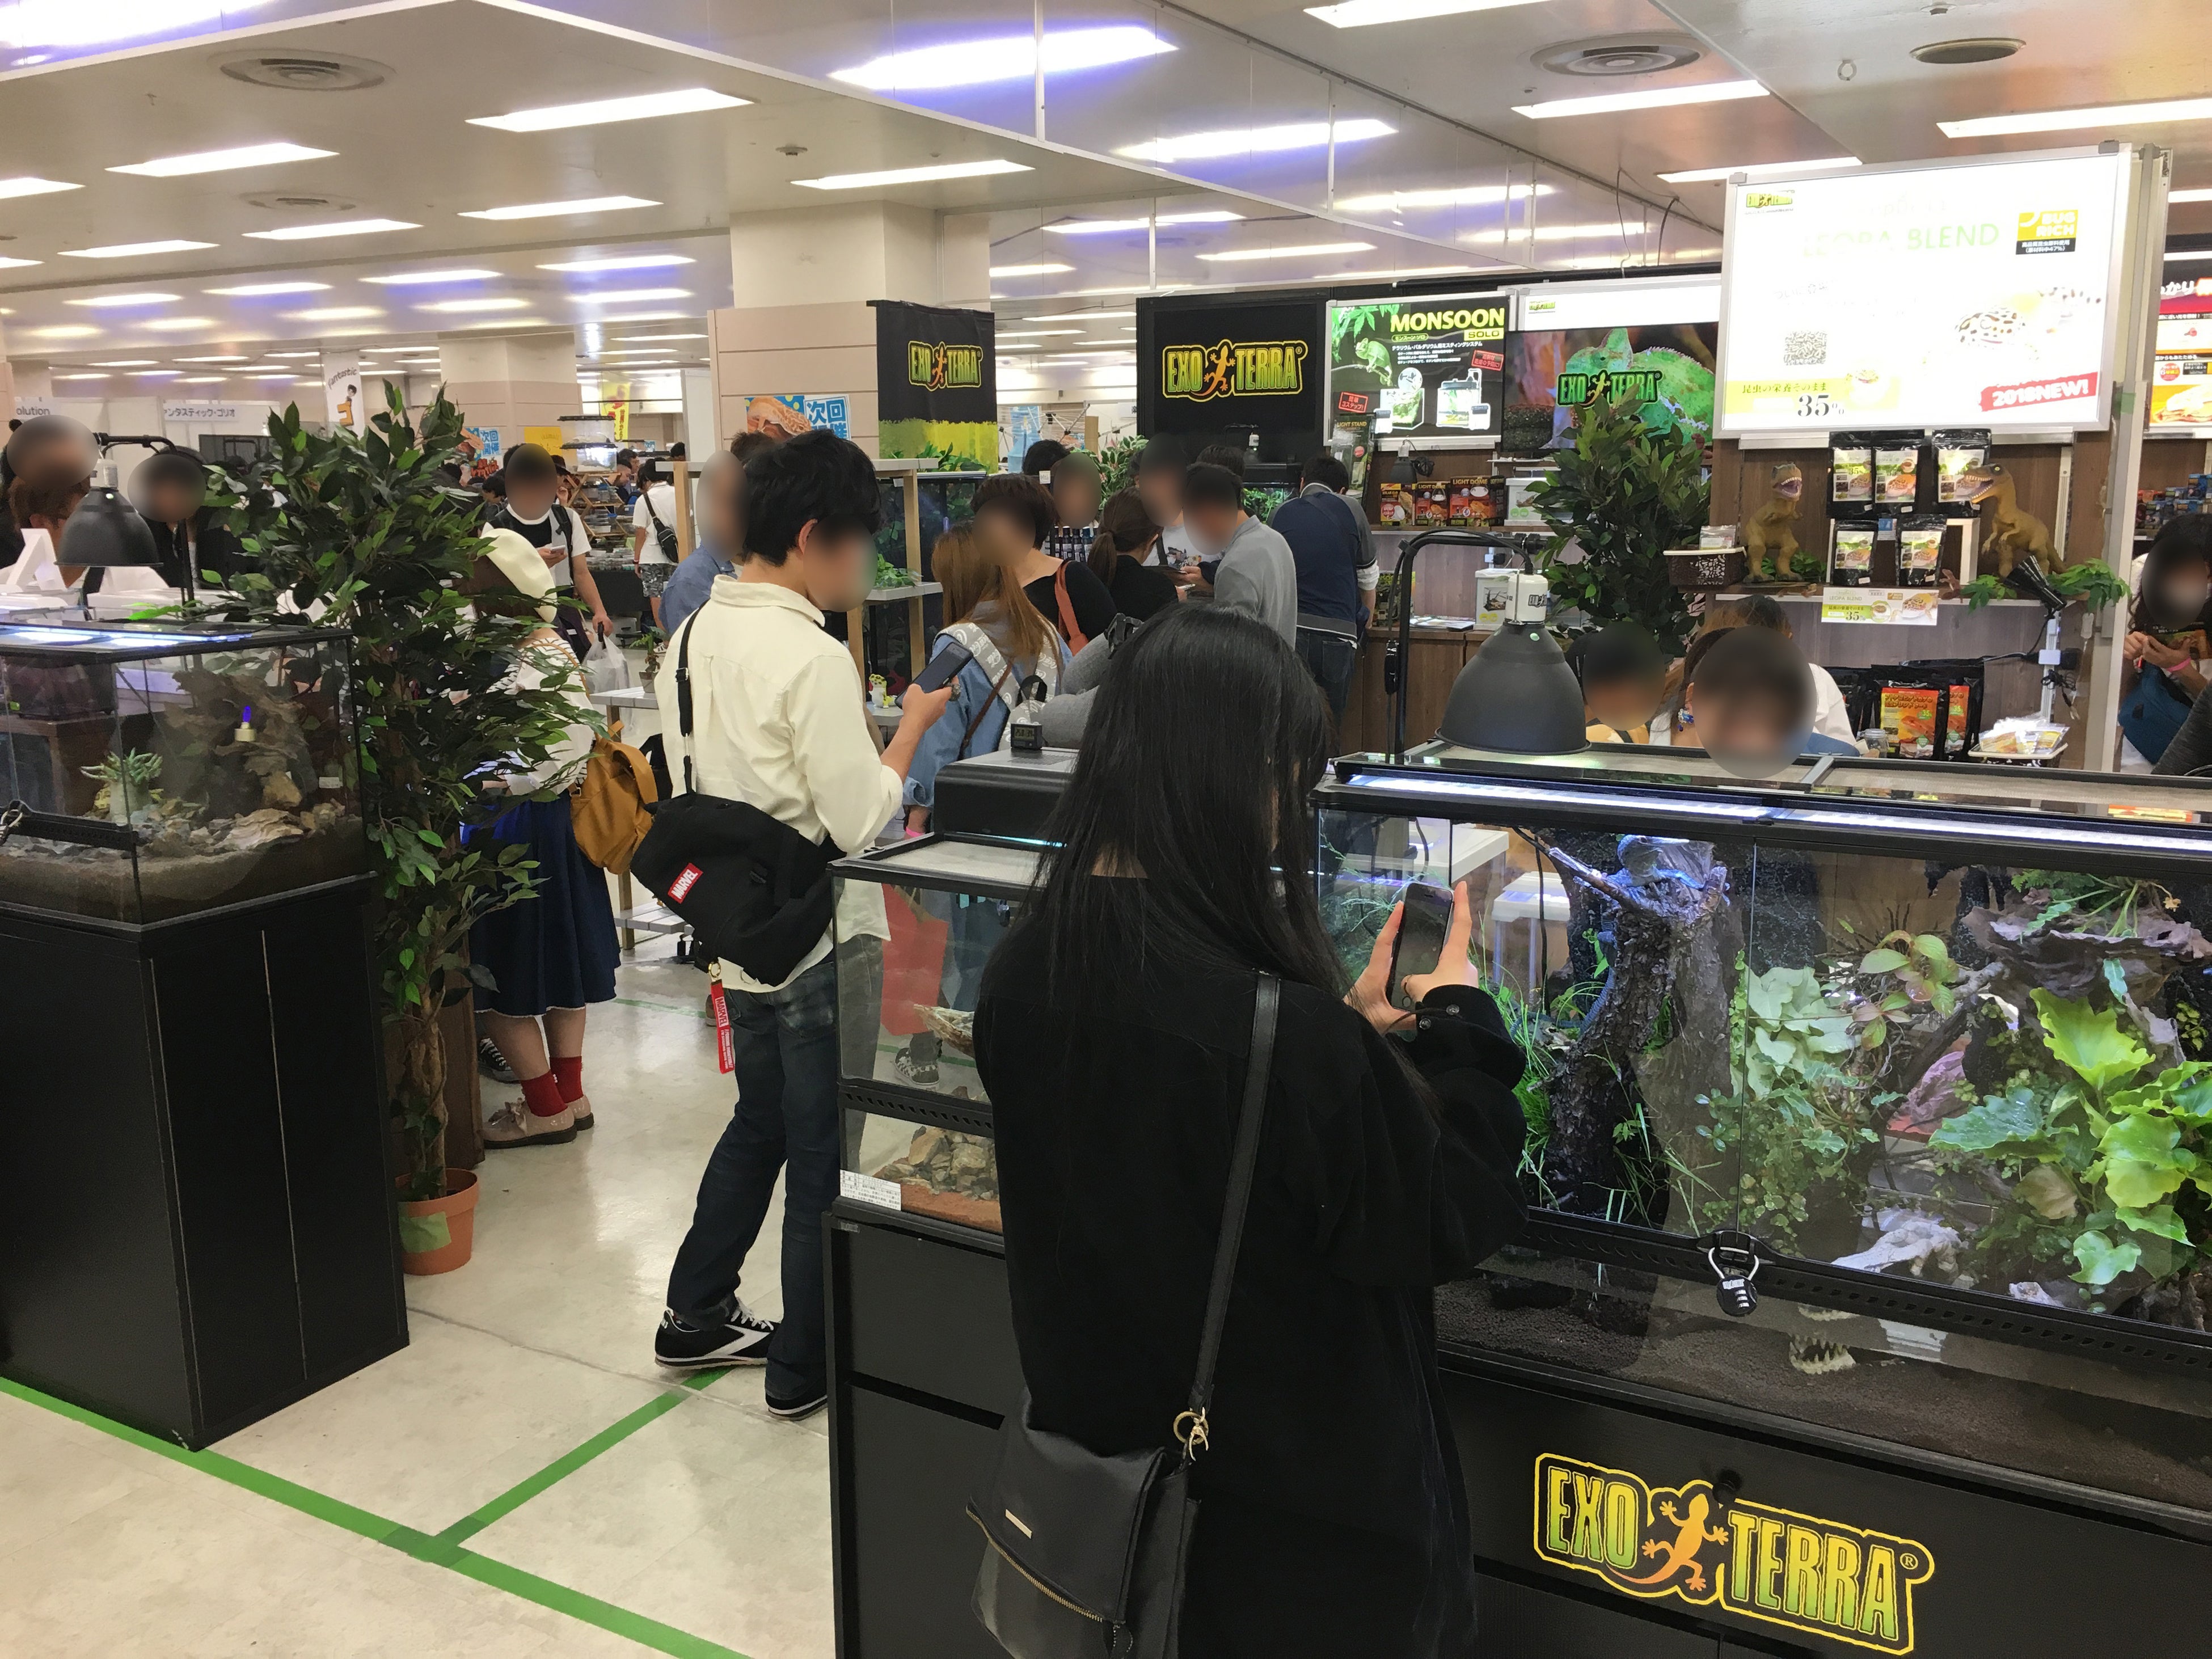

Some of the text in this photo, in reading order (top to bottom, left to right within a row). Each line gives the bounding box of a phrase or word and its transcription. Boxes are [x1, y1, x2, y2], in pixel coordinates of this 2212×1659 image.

[2036, 225, 2075, 237] RICH
[2041, 212, 2076, 225] BUG
[1907, 223, 2000, 250] BLEND
[1390, 307, 1505, 332] MONSOON
[911, 345, 931, 383] EXO
[1167, 350, 1203, 392] EXO
[1560, 374, 1588, 403] EXO
[1742, 382, 1827, 394] 昆虫の栄養そのまま
[16, 406, 50, 416] olution
[807, 399, 847, 425] 次回
[480, 430, 499, 442] 次回
[1530, 595, 1538, 606] EXO
[671, 869, 698, 900] MARVEL
[716, 998, 728, 1026] MARVEL
[1546, 1466, 1639, 1569] EXO
